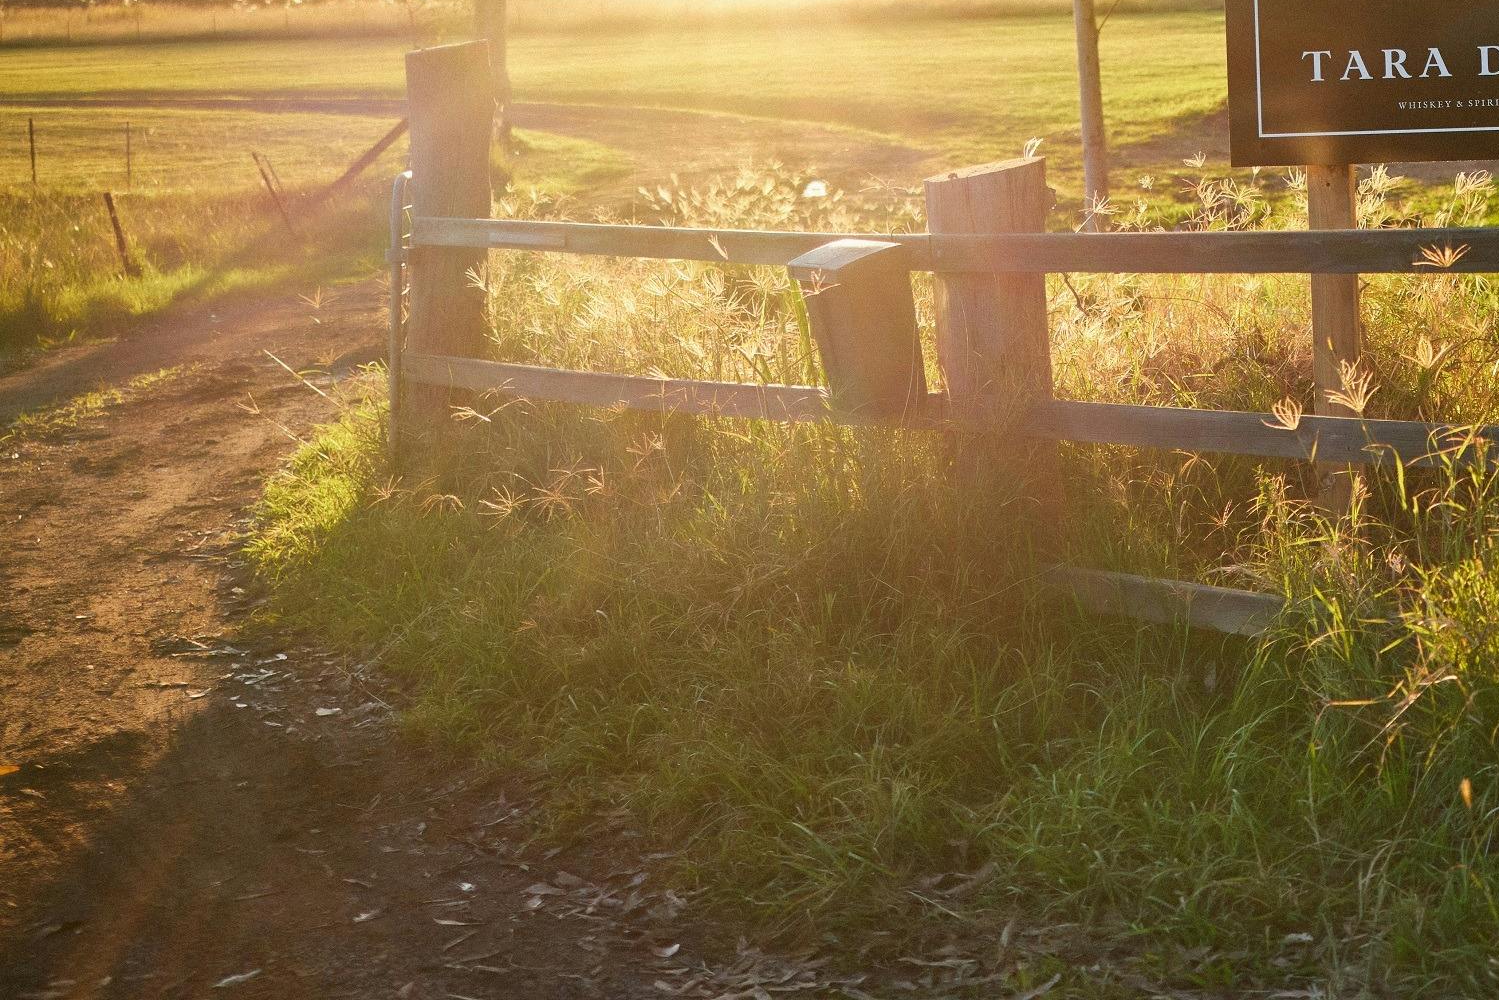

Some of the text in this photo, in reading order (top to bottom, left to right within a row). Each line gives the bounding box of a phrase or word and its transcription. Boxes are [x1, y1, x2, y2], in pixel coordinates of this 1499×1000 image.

[1302, 50, 1451, 82] TARA
[1398, 100, 1451, 110] WHISKEY
[1456, 100, 1463, 109] &
